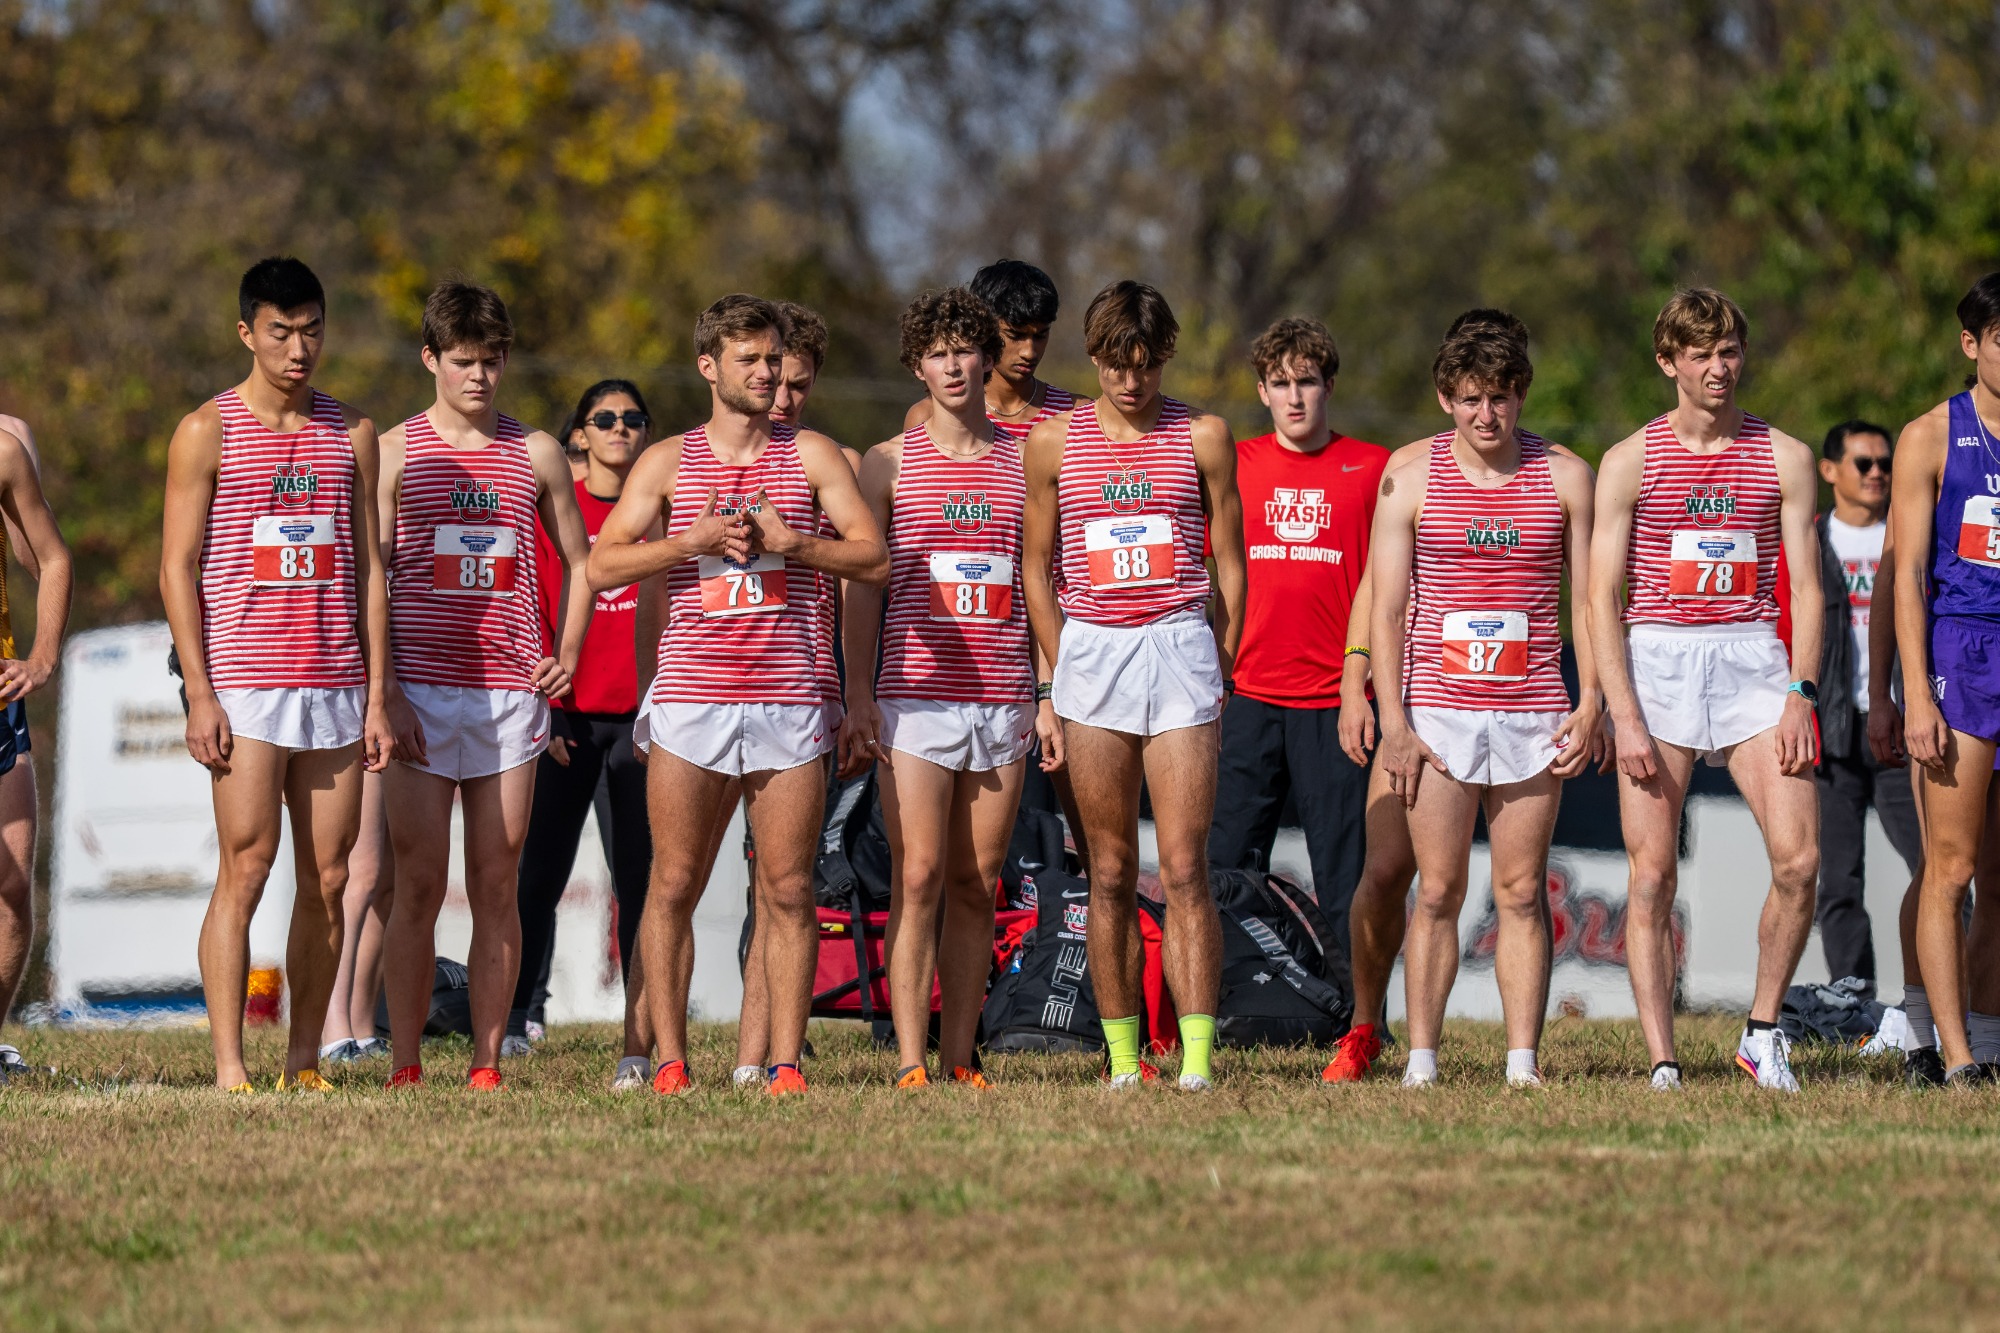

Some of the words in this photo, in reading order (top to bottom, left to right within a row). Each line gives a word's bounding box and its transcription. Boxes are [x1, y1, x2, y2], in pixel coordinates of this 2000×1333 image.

[1957, 436, 1980, 447] UAA
[271, 473, 319, 494] WASH
[1101, 481, 1153, 502] WASH
[449, 491, 500, 511] WASH
[1685, 496, 1736, 515] WASH
[942, 503, 992, 522] WASH
[1265, 501, 1331, 529] WASH
[288, 533, 306, 542] UAA
[1119, 534, 1138, 543] UAA
[1465, 528, 1521, 547] WASH
[468, 543, 487, 552] UAA
[1249, 545, 1287, 560] CROSS
[1290, 545, 1343, 565] COUNTRY
[1706, 549, 1725, 558] UAA
[280, 547, 316, 578] 83
[1112, 547, 1150, 579] 88
[460, 557, 496, 588] 85
[965, 571, 982, 579] UAA
[1696, 562, 1734, 594] 78
[726, 574, 764, 606] 79
[609, 602, 617, 612] &
[618, 597, 638, 612] FIEL
[955, 584, 989, 616] 81
[1477, 628, 1495, 637] UAA
[1468, 641, 1504, 673] 87
[1065, 911, 1087, 925] WAS
[1057, 931, 1074, 939] CROSS
[1041, 943, 1088, 1031] ELITE
